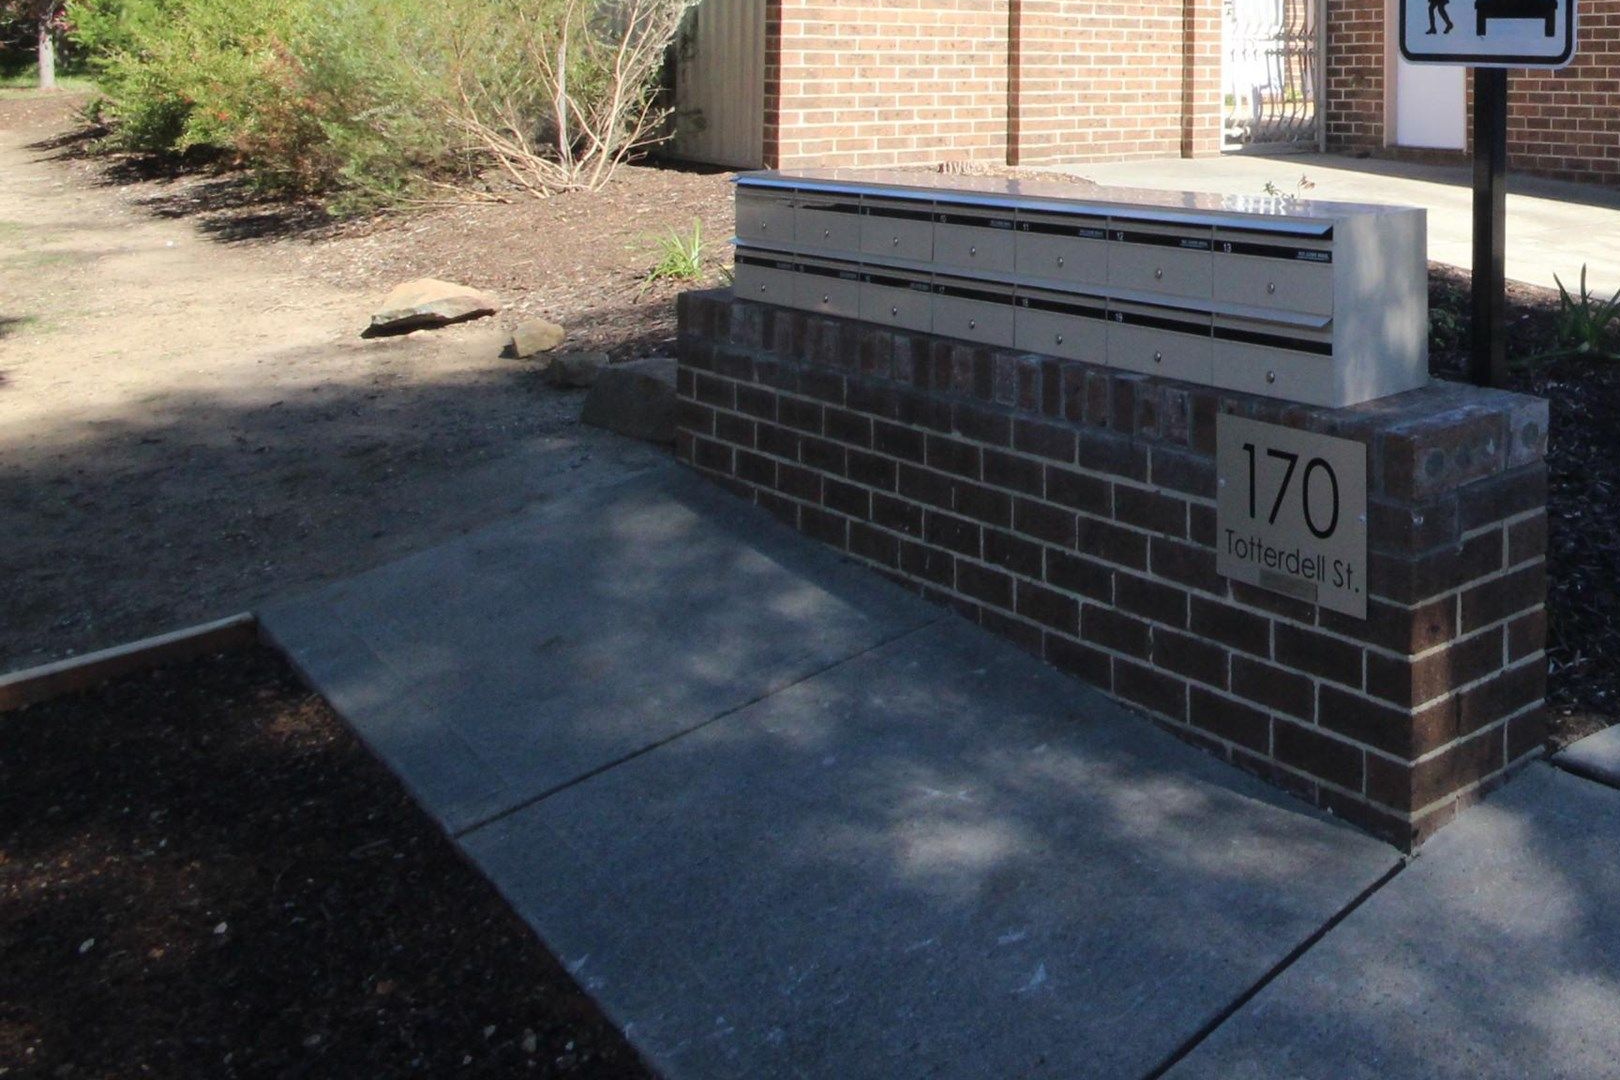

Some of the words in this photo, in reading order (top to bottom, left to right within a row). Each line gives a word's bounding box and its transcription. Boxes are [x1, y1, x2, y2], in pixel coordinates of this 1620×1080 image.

[1242, 443, 1340, 539] 170
[1225, 528, 1325, 582] Totterdell
[1332, 559, 1360, 594] St.
